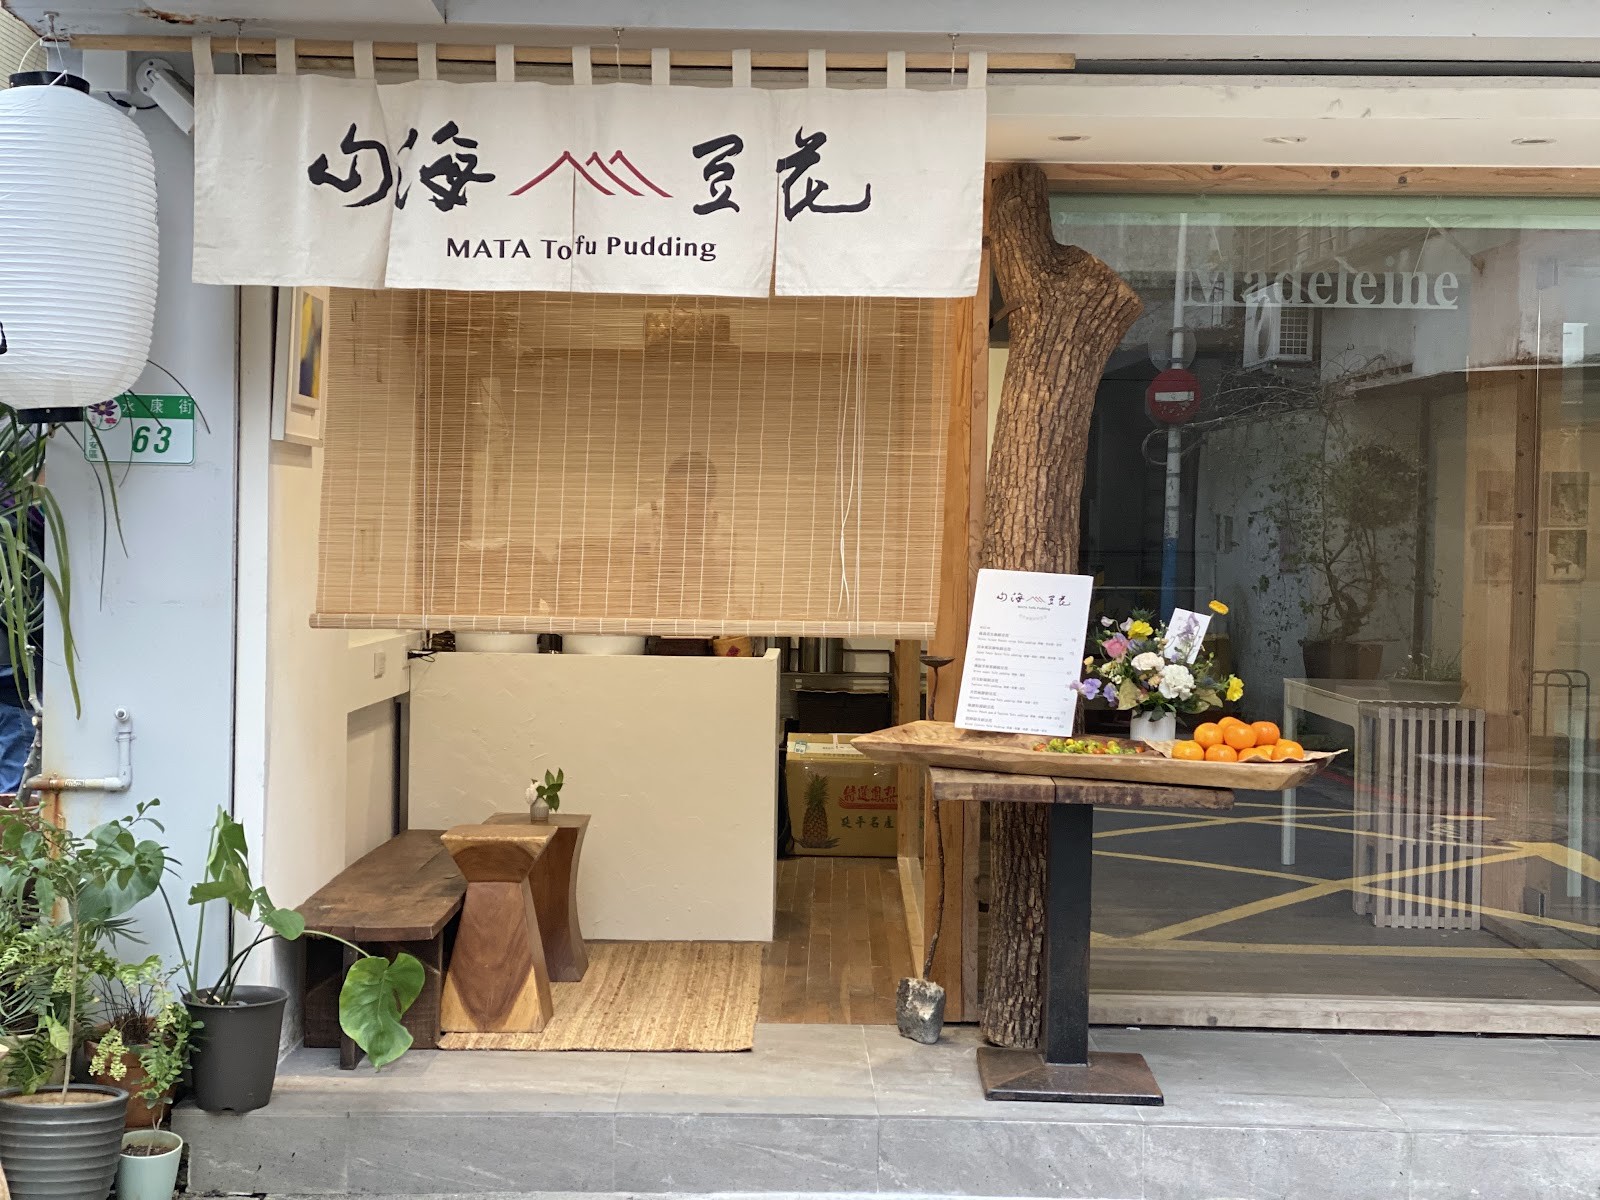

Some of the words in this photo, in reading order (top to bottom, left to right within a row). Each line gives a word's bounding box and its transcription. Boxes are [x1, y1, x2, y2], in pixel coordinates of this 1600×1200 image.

[693, 126, 871, 222] 豆花
[446, 237, 531, 259] MATA
[540, 235, 597, 260] Tofu
[607, 236, 717, 262] Pudding
[1183, 257, 1458, 305] Madeleine
[122, 397, 192, 415] 永康街
[132, 425, 172, 454] 63
[843, 785, 898, 802] 特選鳳梨
